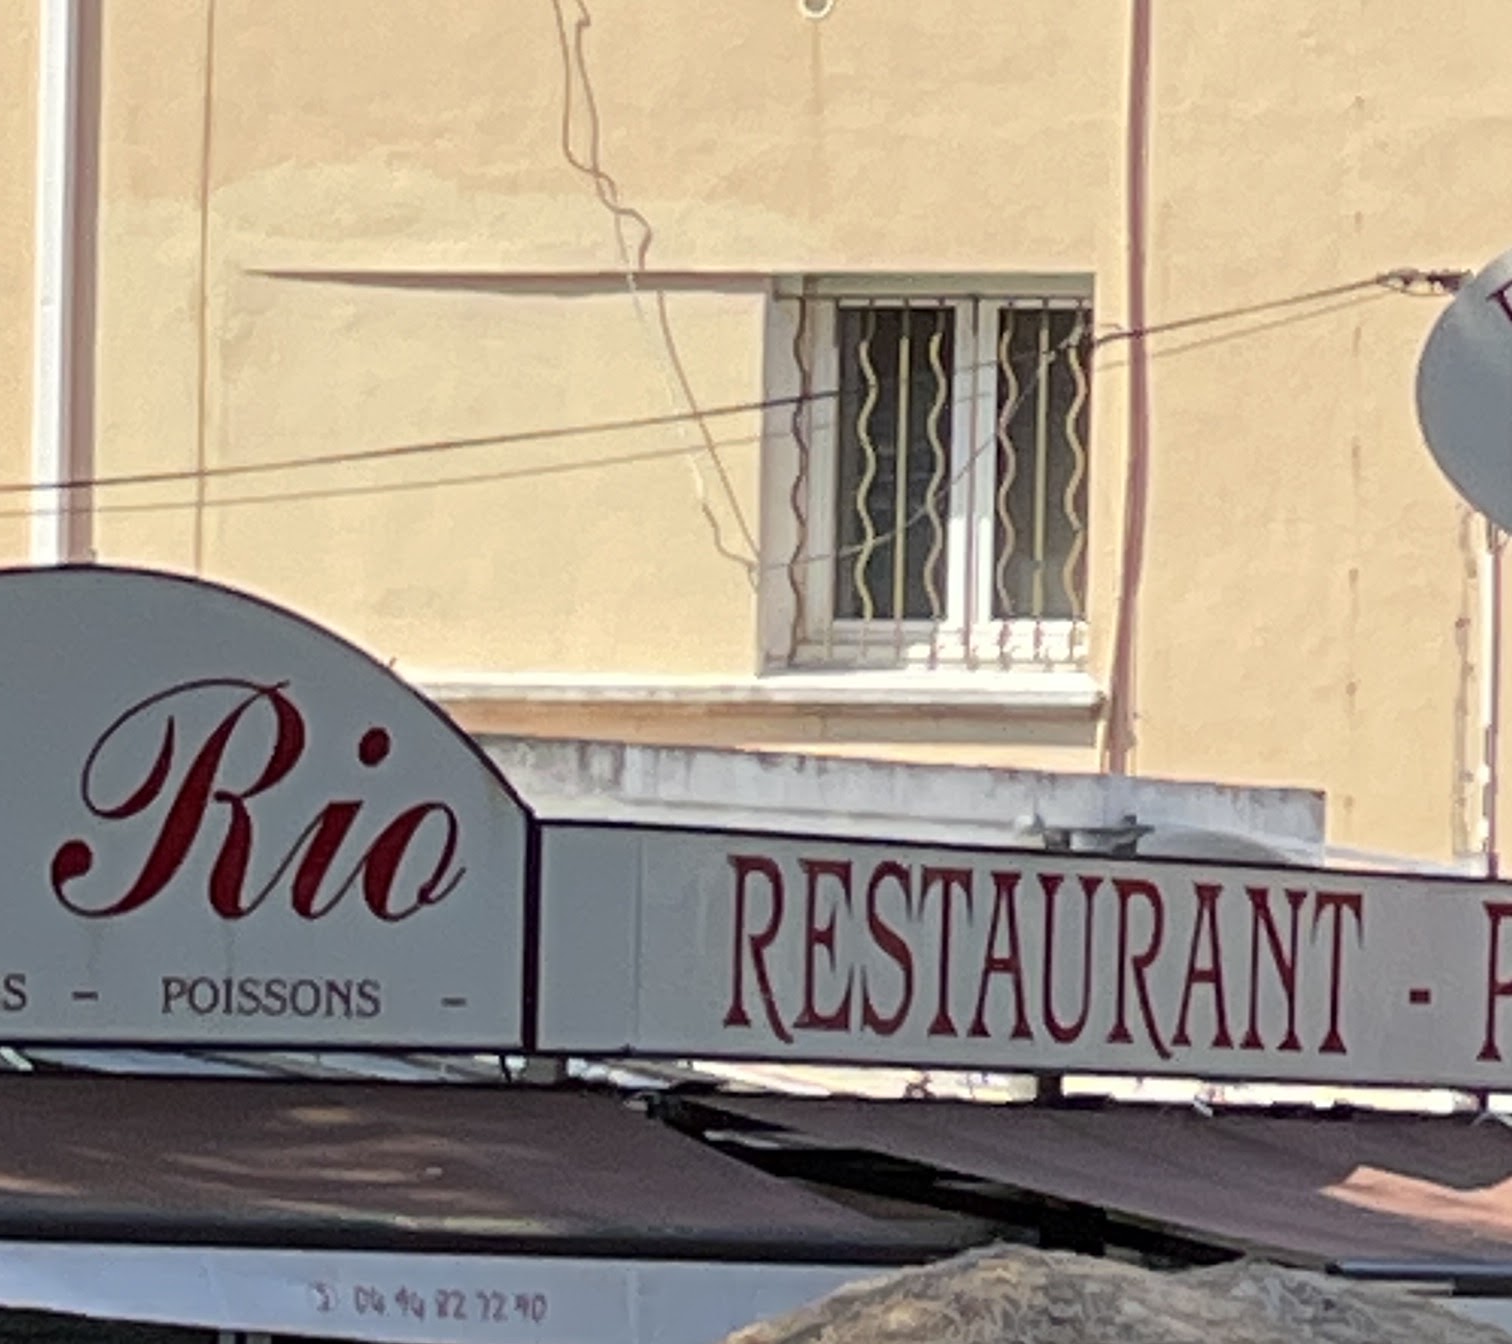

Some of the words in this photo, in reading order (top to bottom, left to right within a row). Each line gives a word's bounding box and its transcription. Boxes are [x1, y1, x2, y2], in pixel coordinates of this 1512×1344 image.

[50, 678, 466, 922] Rio
[161, 975, 383, 1018] POISSONS
[723, 854, 1365, 1060] RESTAURANT
